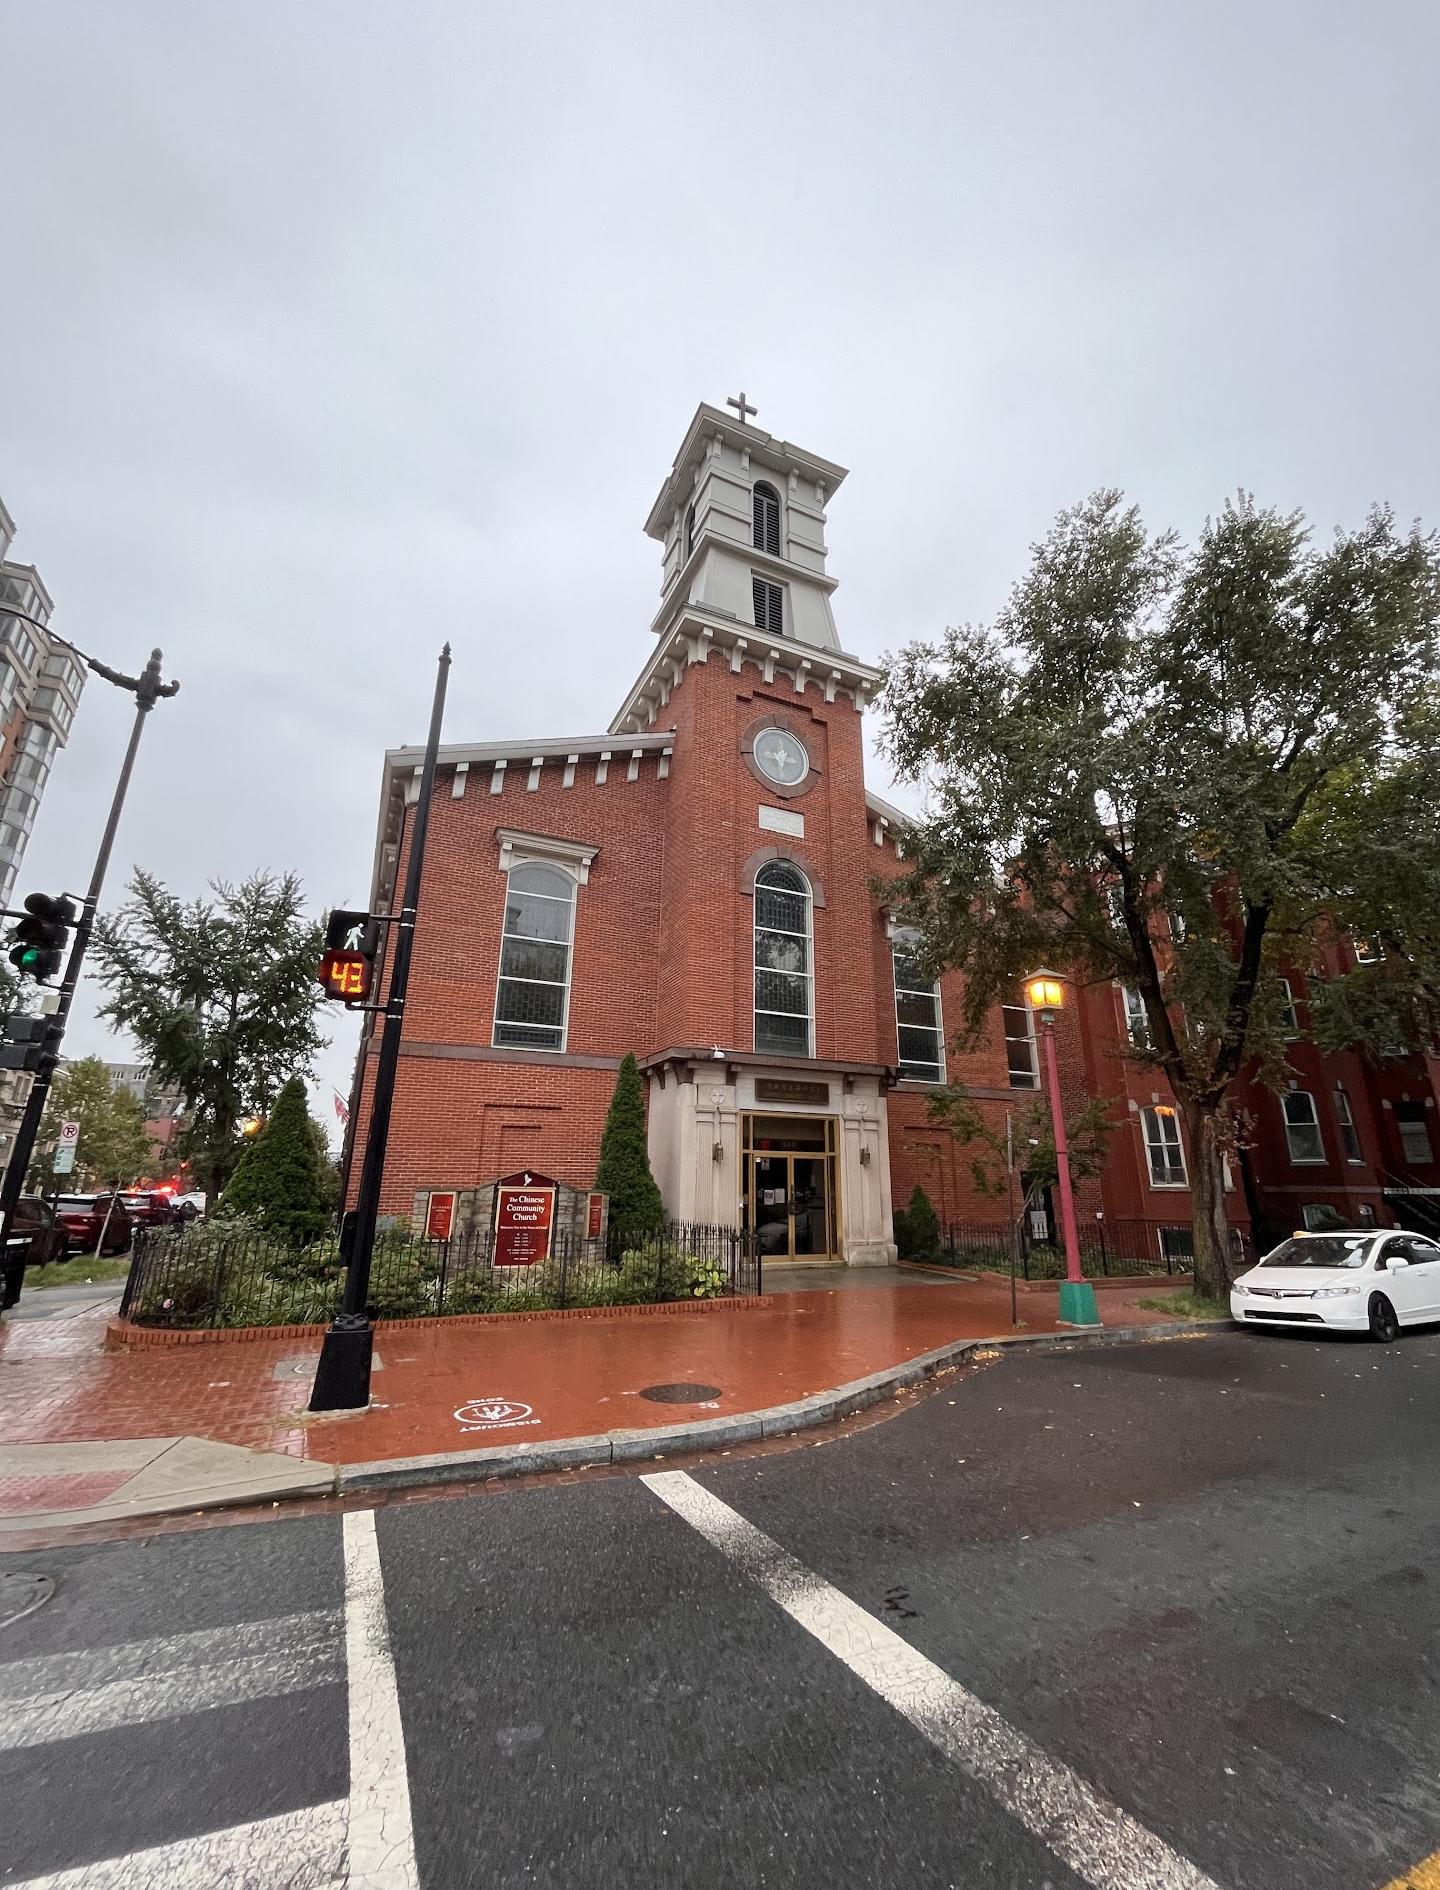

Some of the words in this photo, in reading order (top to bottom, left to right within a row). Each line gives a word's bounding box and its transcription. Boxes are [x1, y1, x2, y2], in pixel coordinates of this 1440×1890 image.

[331, 961, 363, 993] 43
[518, 1195, 545, 1204] Chinese
[506, 1203, 546, 1214] Community
[512, 1212, 538, 1221] Church
